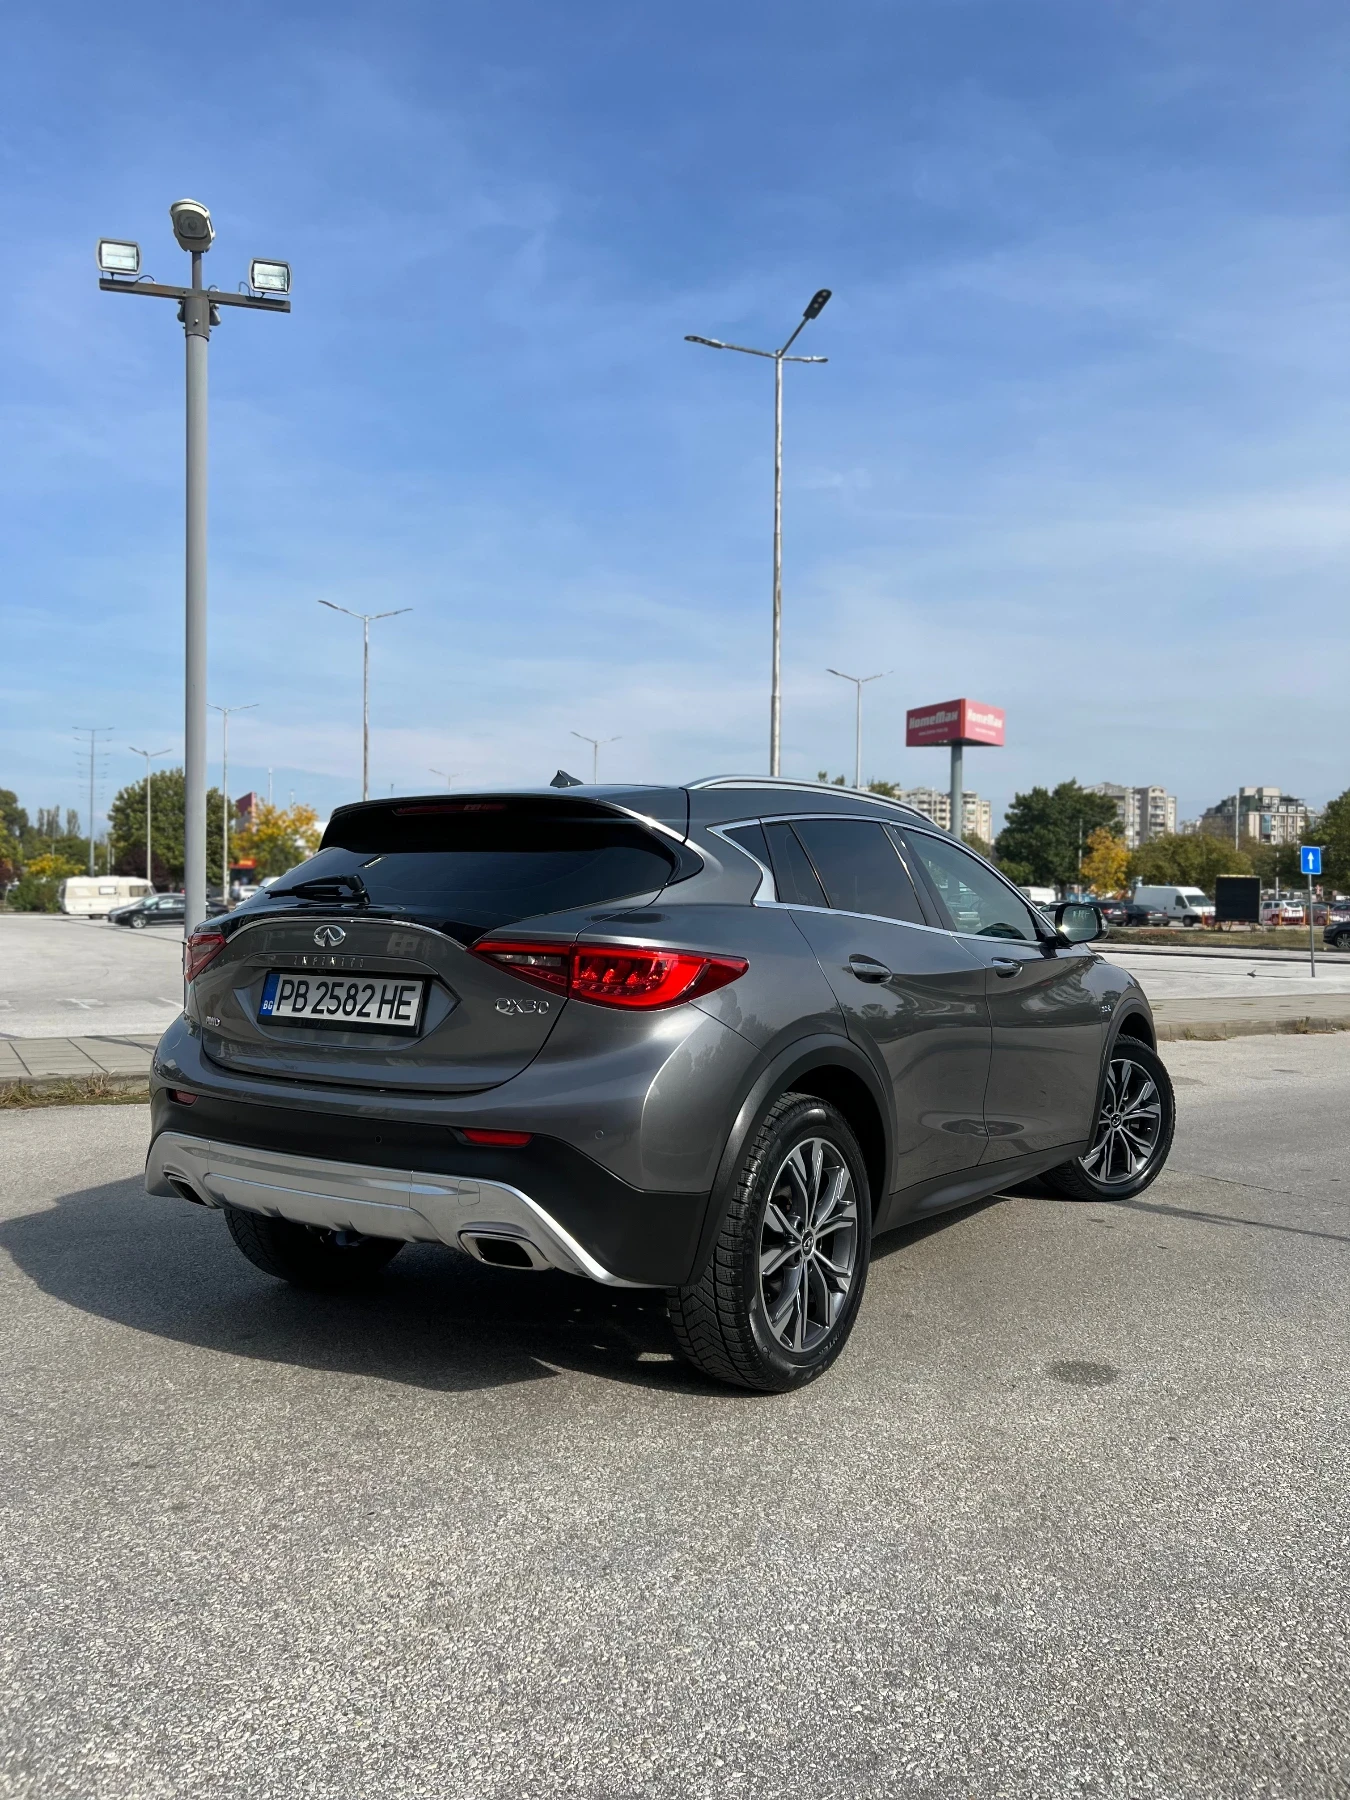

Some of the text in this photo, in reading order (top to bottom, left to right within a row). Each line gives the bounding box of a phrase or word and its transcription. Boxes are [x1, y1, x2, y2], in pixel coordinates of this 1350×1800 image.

[263, 1000, 274, 1010] BG
[276, 979, 416, 1020] PB 2582 HE
[495, 997, 550, 1016] QX30
